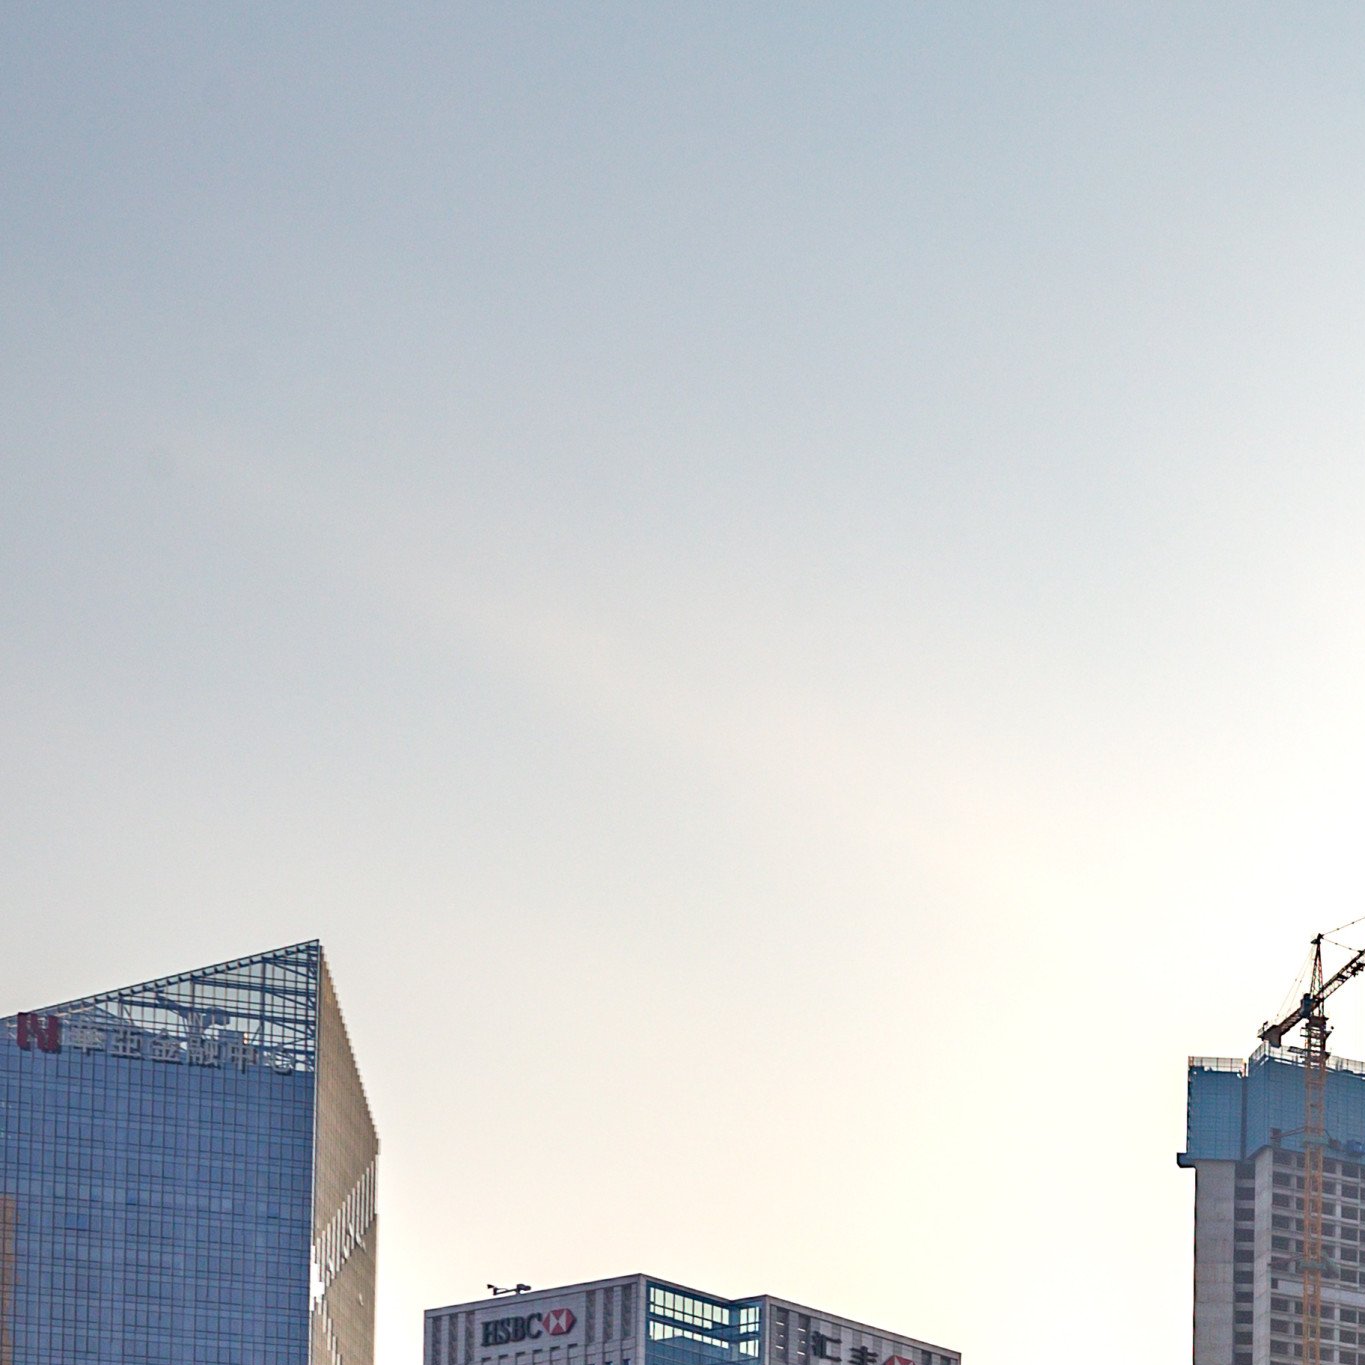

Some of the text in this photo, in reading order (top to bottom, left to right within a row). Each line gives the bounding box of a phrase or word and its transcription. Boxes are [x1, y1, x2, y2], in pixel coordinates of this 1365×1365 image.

[69, 1024, 298, 1077] 華亞金融中心
[481, 1312, 543, 1347] HSBC
